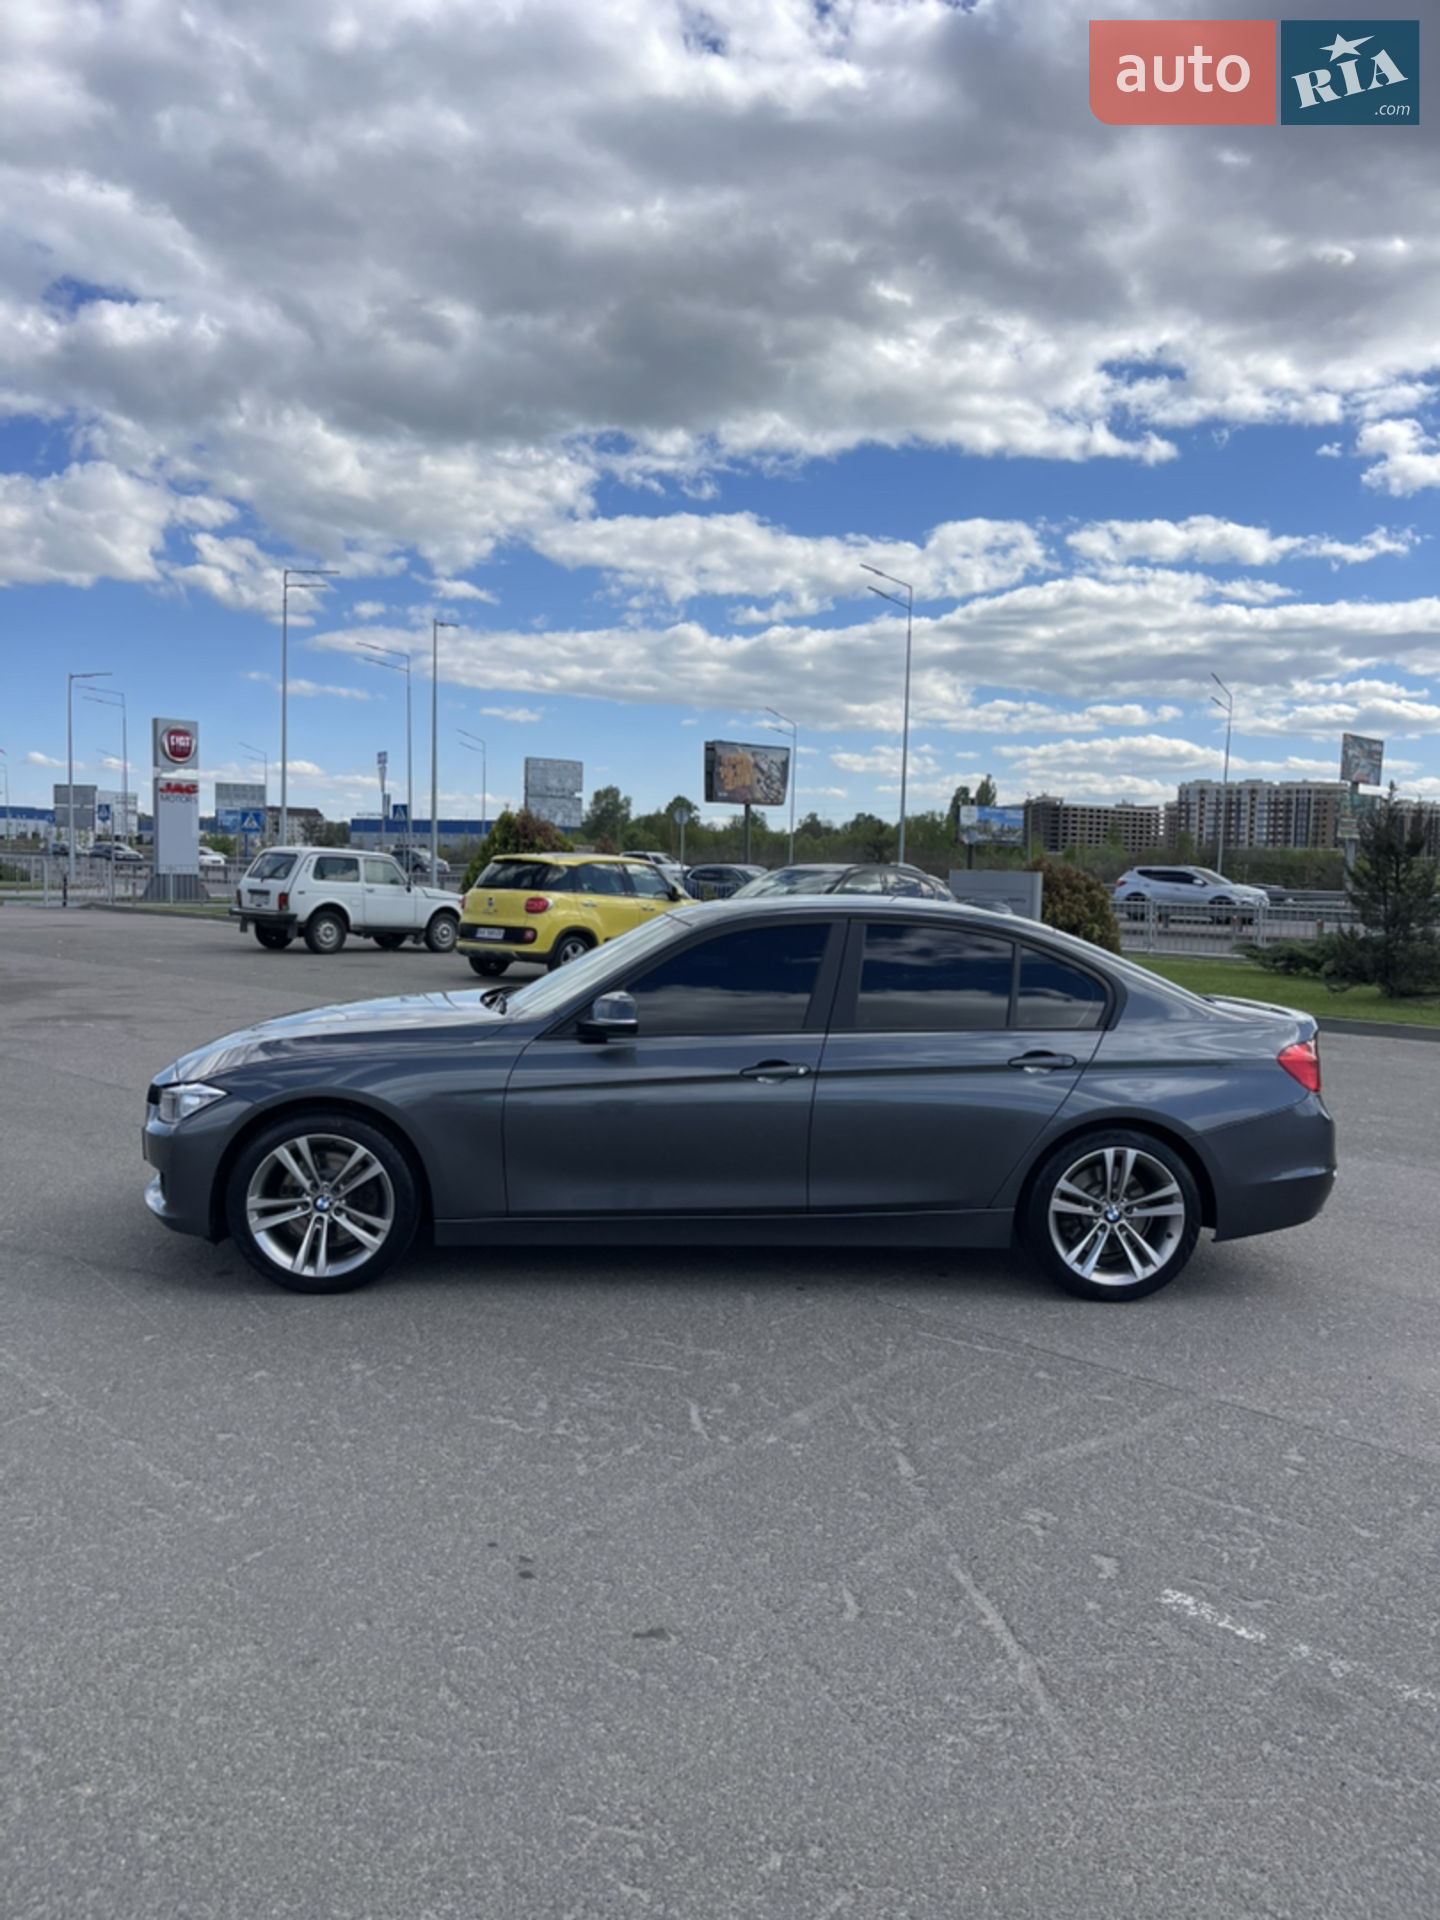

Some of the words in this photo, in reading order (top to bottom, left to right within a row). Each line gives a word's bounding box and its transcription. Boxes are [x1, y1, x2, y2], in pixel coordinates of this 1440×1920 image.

[170, 735, 191, 746] FIAT
[159, 782, 199, 794] JAC
[160, 794, 198, 803] MOTORS
